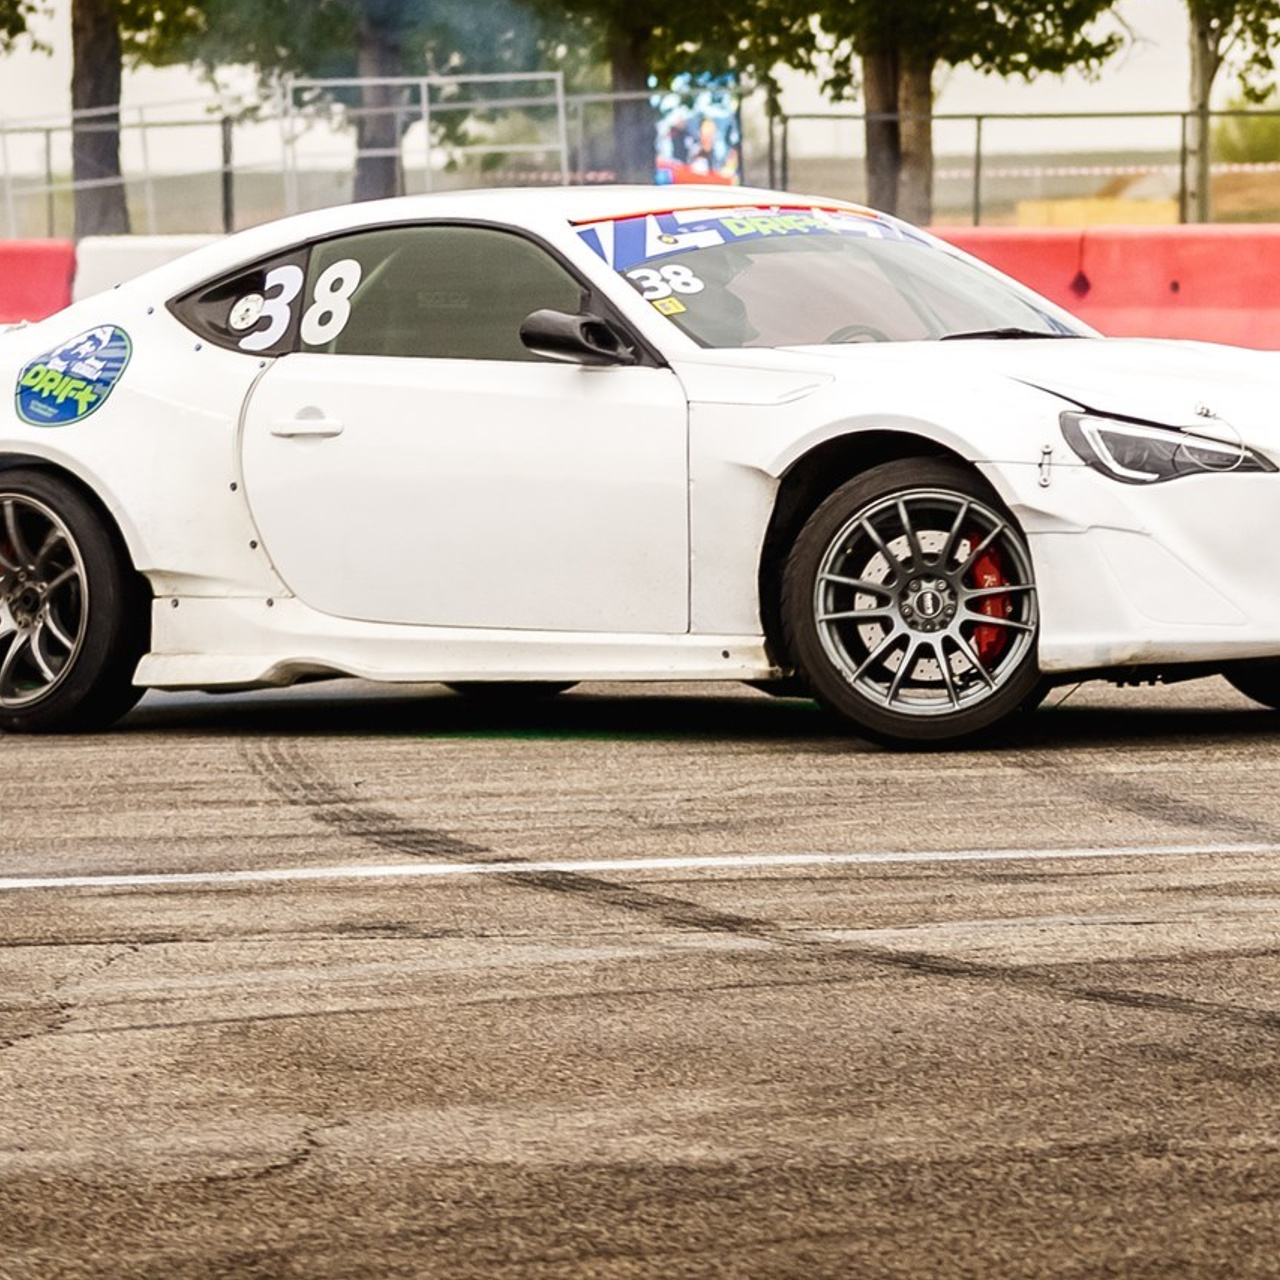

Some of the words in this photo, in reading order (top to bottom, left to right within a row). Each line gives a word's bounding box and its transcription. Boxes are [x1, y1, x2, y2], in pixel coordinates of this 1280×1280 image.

[719, 214, 842, 236] DRIFT
[625, 264, 705, 300] 38
[238, 258, 362, 352] 38
[20, 363, 99, 417] DRIFT
